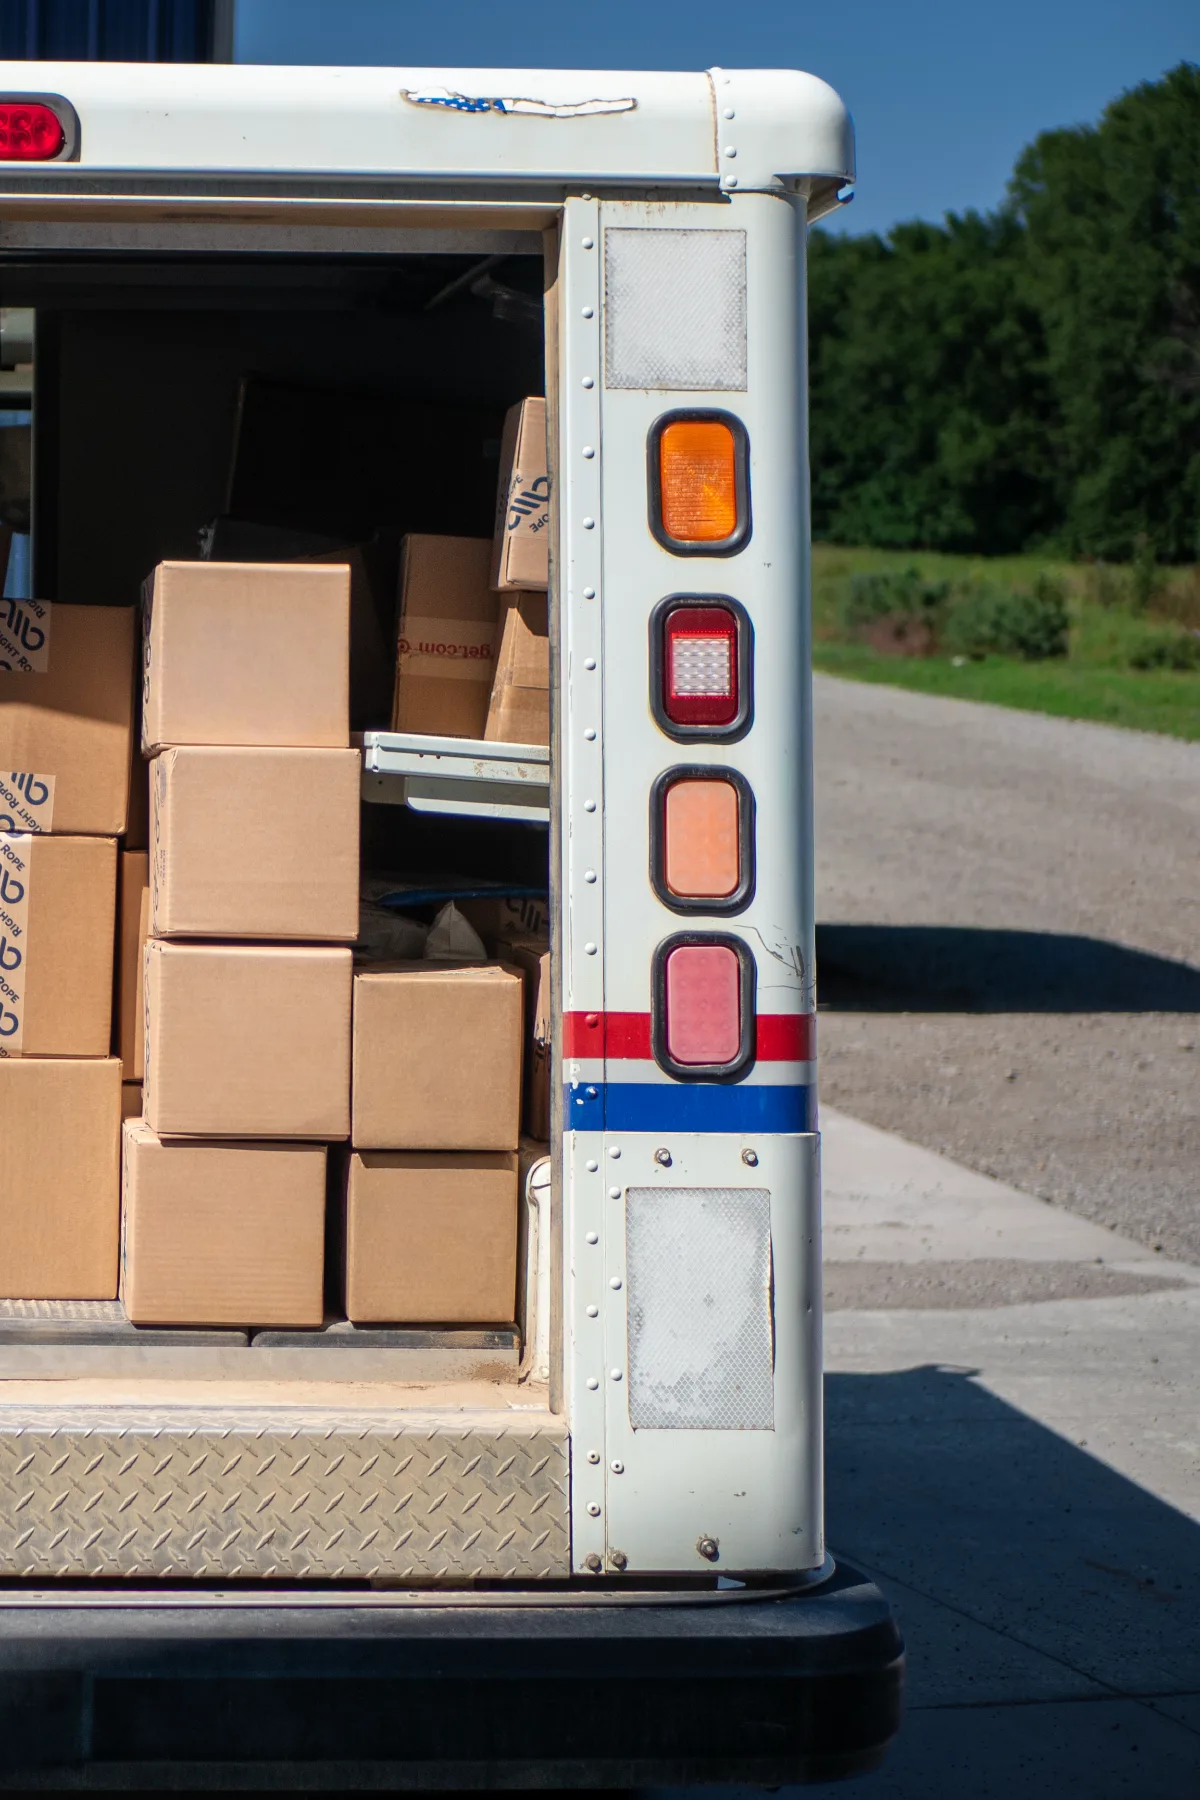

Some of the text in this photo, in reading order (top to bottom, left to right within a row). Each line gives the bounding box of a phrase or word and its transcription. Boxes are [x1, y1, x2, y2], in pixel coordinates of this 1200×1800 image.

[529, 513, 549, 533] OPE
[25, 599, 46, 619] RIG
[16, 807, 43, 832] IGHT
[0, 843, 26, 872] ROPE
